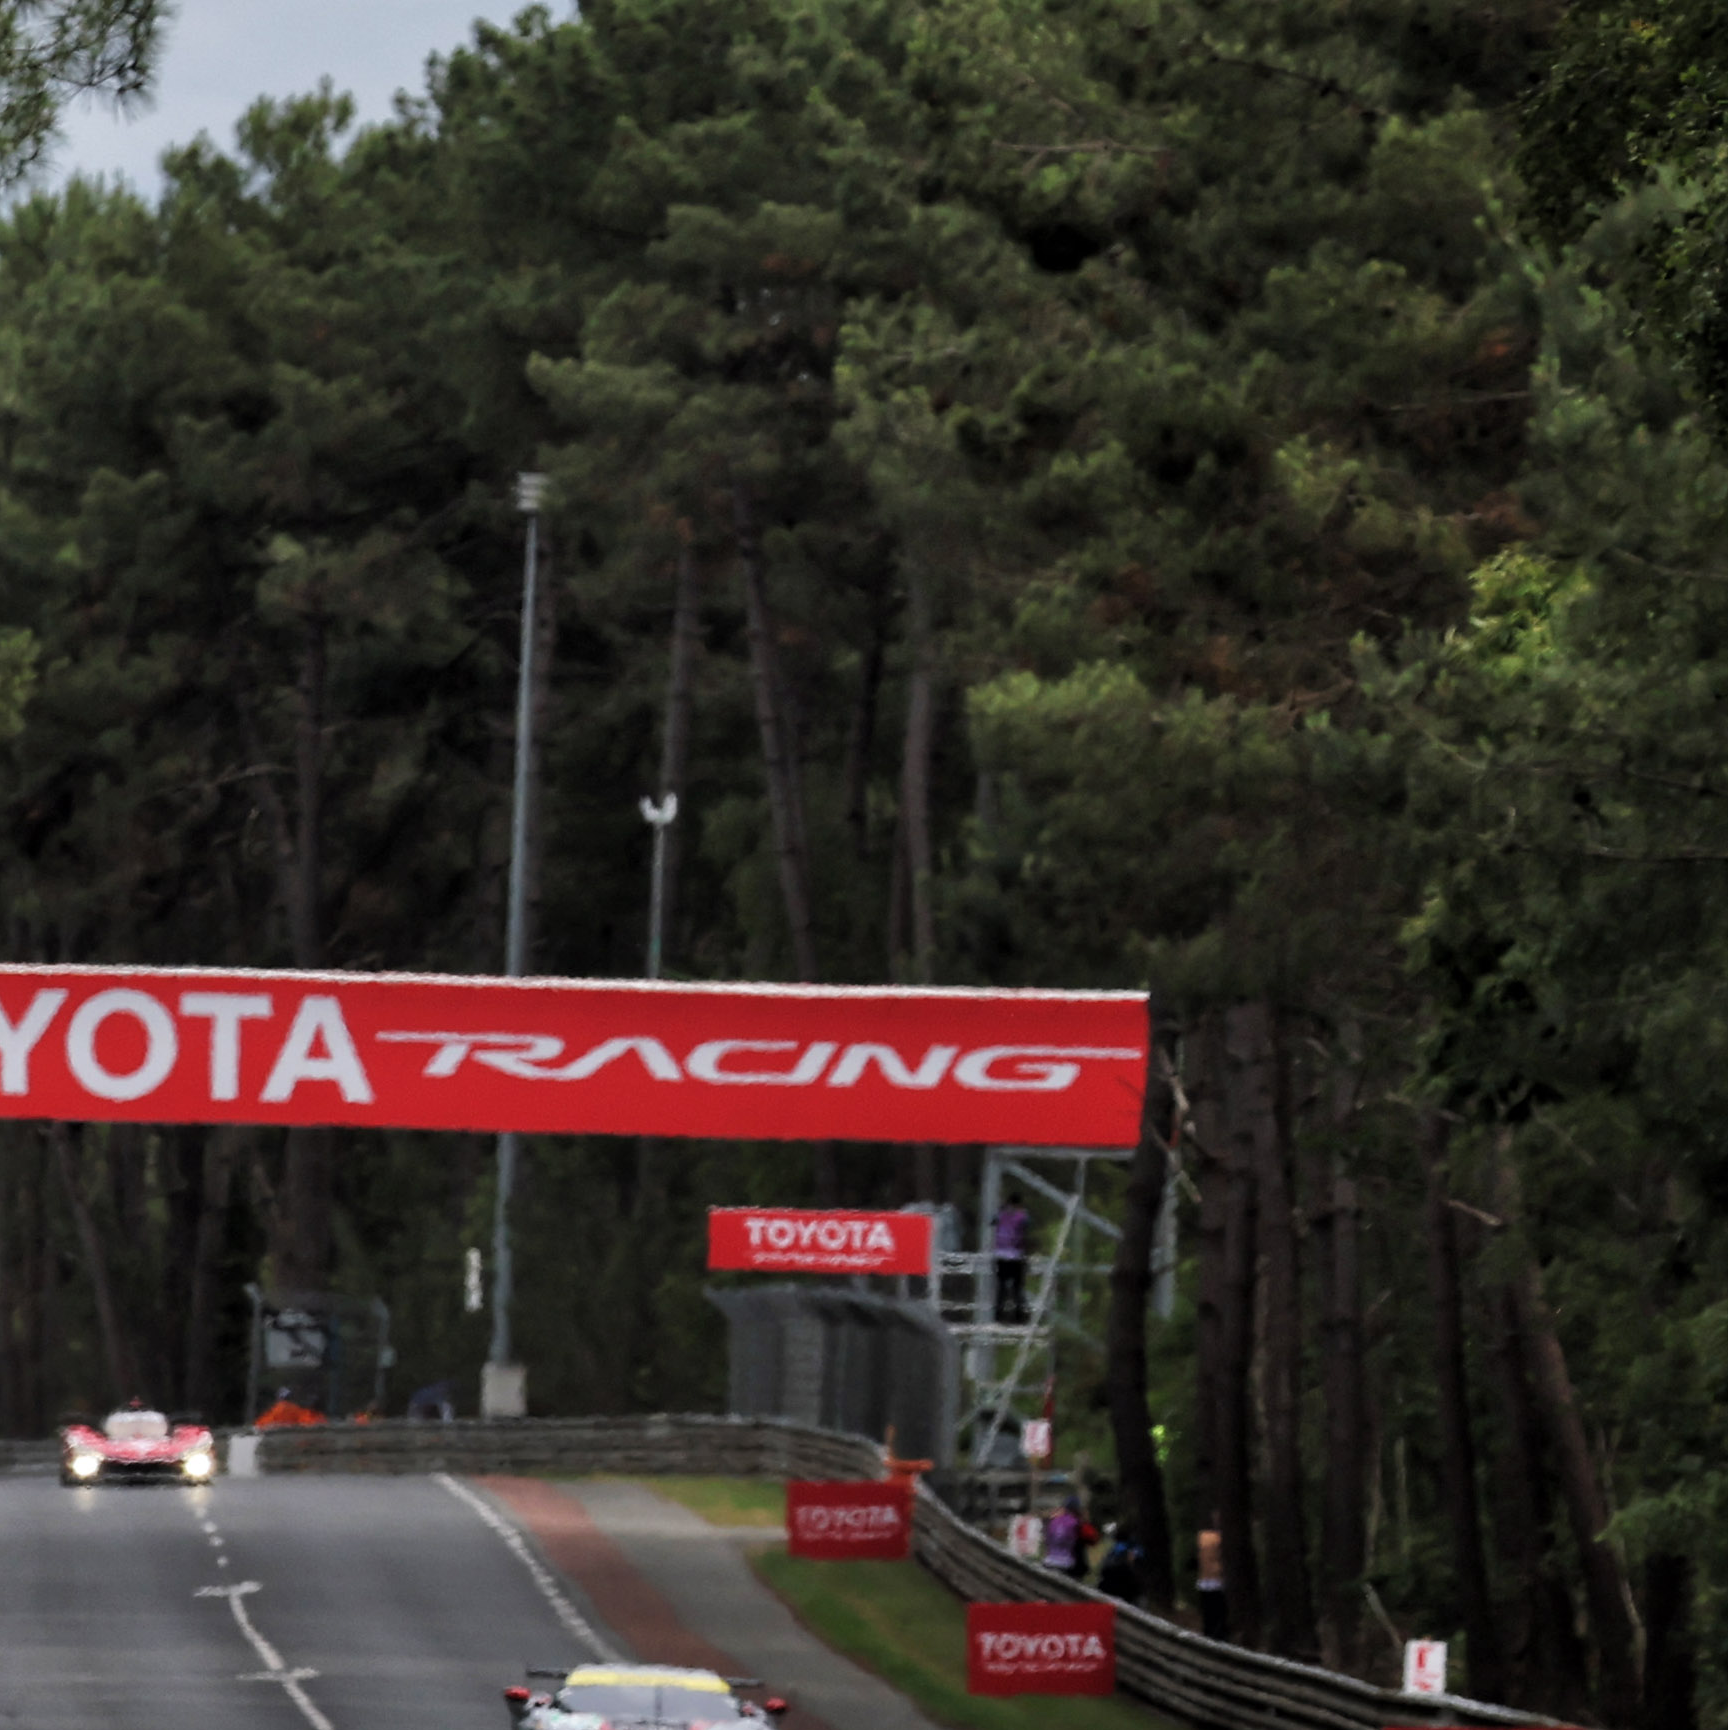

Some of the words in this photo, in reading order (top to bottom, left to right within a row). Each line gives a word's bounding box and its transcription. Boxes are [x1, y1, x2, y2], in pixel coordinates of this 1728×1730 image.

[375, 1031, 1142, 1090] RACING
[745, 1217, 894, 1251] TOYOTA
[978, 1632, 1105, 1659] TOYOTA
